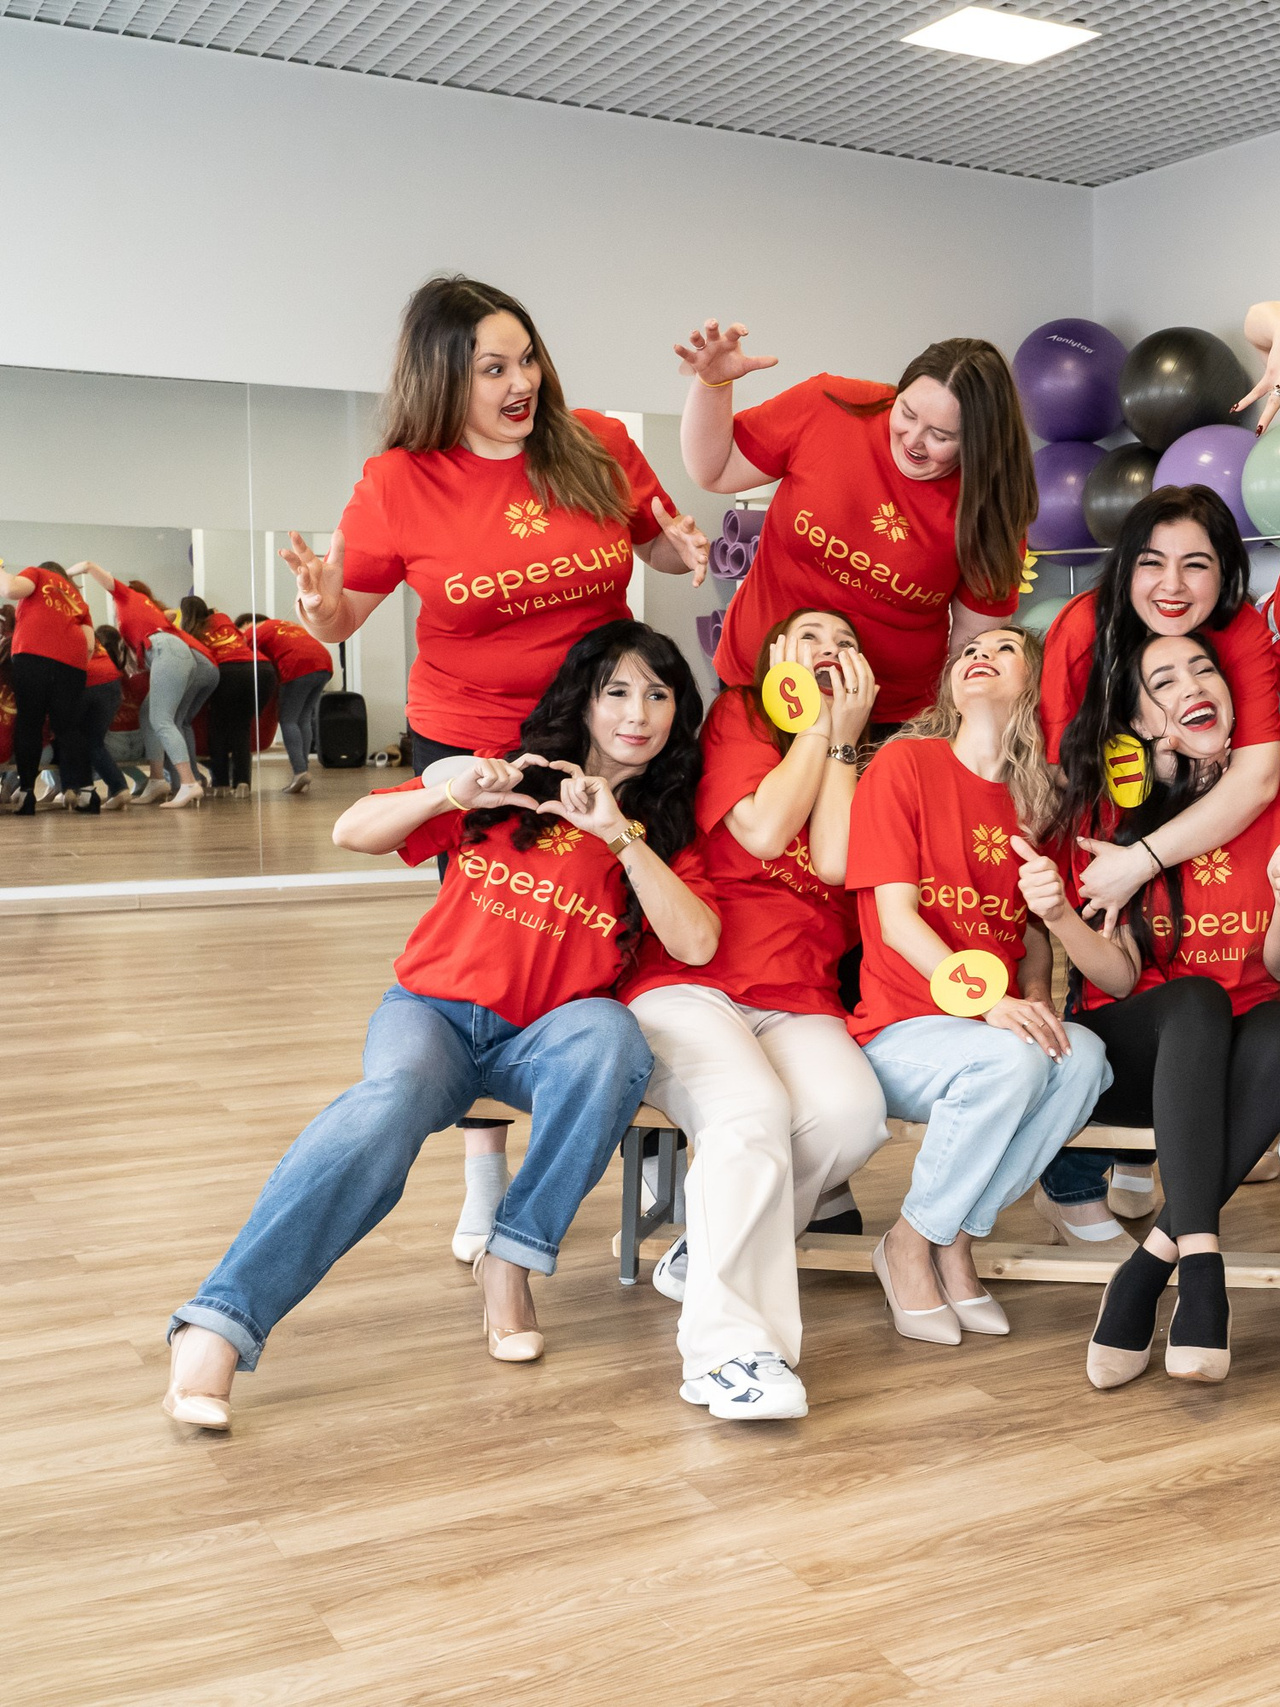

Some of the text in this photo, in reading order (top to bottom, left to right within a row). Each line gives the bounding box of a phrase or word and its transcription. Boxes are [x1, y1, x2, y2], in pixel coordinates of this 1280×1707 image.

[444, 539, 632, 605] берегиня
[794, 509, 946, 606] берегиня
[497, 580, 615, 615] чувашии
[1108, 752, 1144, 789] 11
[470, 891, 567, 942] чувашии
